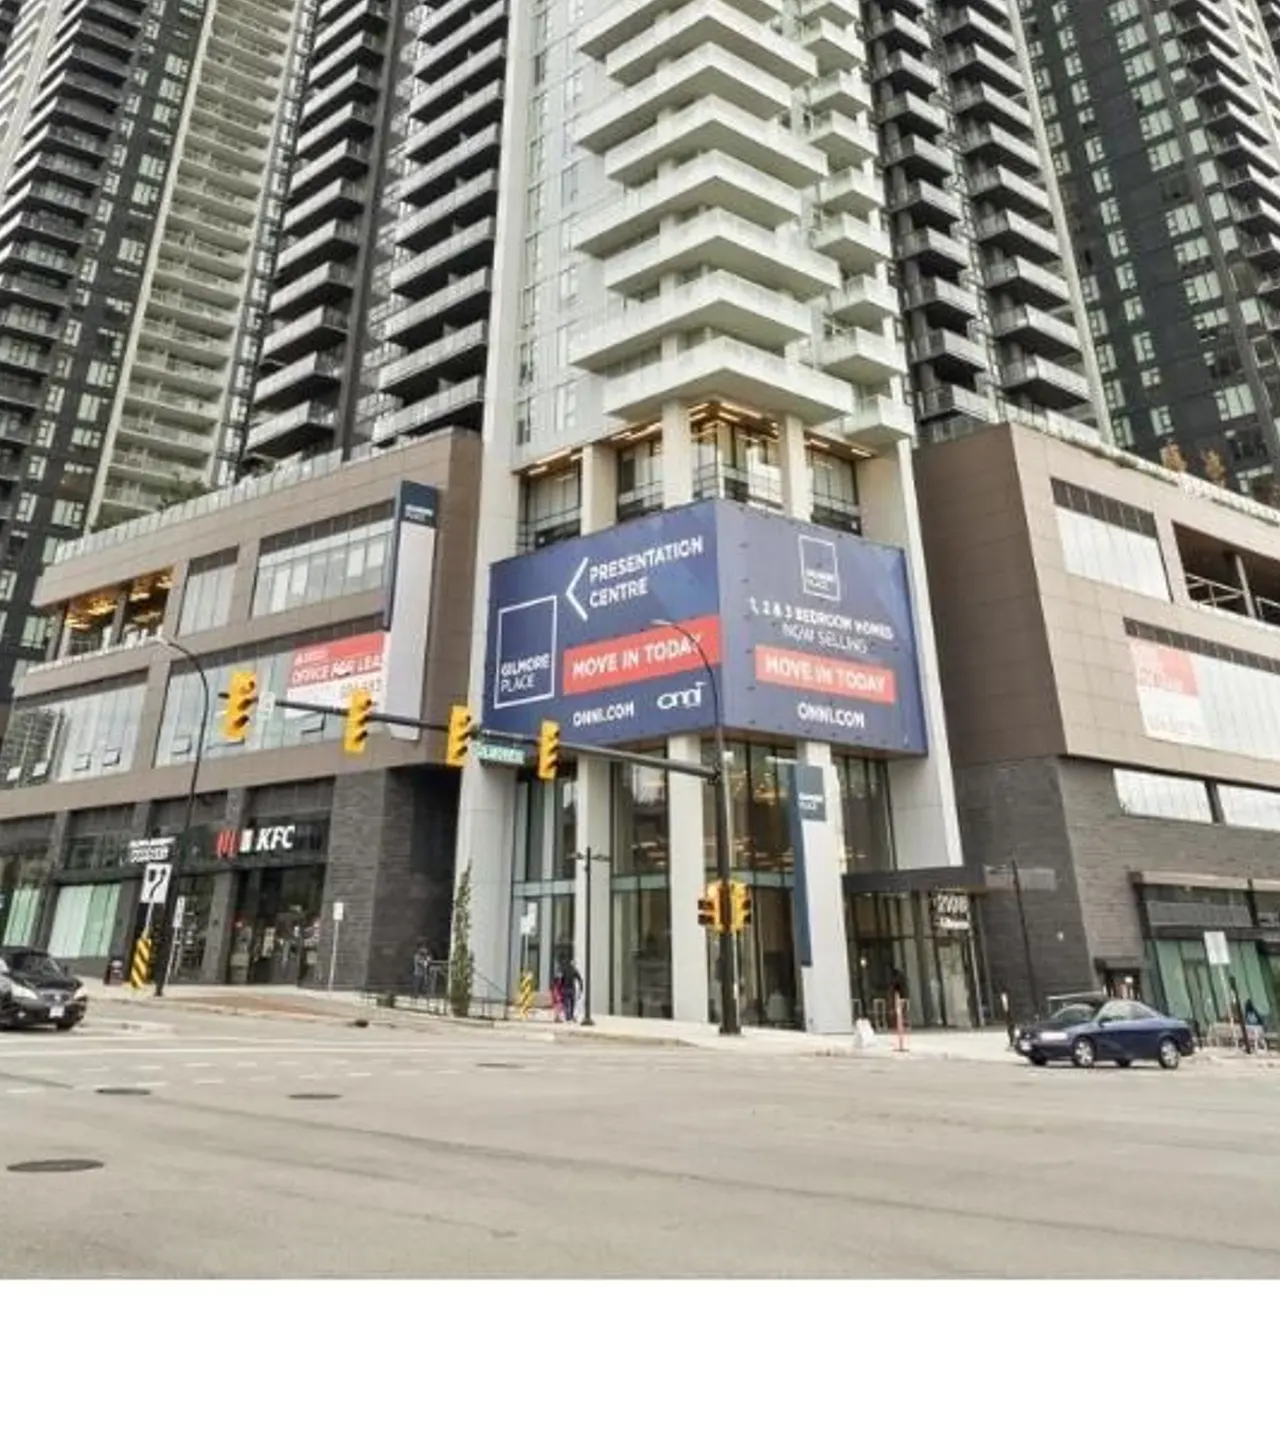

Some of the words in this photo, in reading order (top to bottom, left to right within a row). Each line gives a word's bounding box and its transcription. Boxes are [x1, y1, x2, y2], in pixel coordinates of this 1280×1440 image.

[588, 535, 704, 585] PRESENTATION
[588, 577, 649, 609] CENTRE
[794, 606, 854, 632] BEDROOM
[781, 623, 815, 642] NOW
[817, 630, 869, 655] SELLING
[356, 650, 383, 672] LEA
[500, 652, 551, 677] GILMORE
[572, 649, 618, 678] MOVE
[622, 646, 640, 669] IN
[644, 631, 703, 664] TODAY
[500, 672, 536, 693] PLACE
[764, 654, 814, 681] MOVE
[815, 666, 833, 685] IN
[835, 669, 888, 694] TODAY
[572, 701, 635, 727] ONNI.COM
[796, 701, 866, 729] ONNI.COM
[255, 824, 296, 852] KFC
